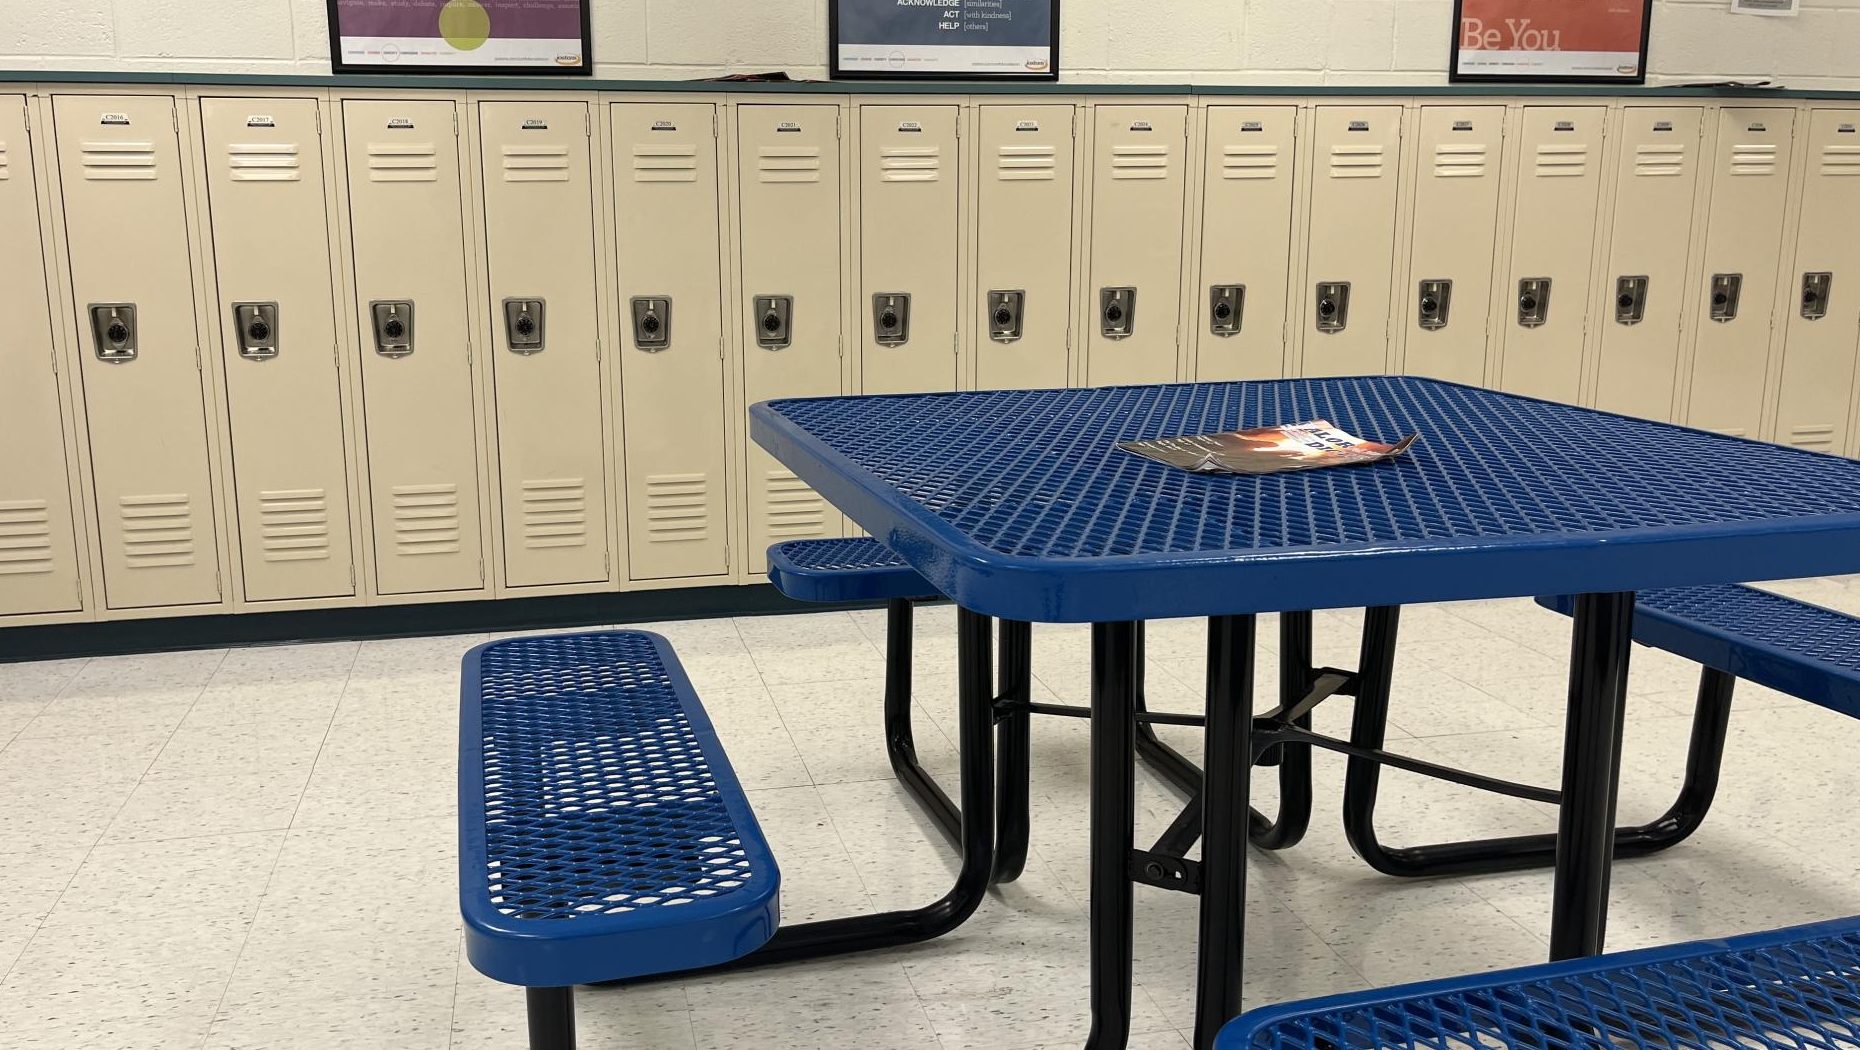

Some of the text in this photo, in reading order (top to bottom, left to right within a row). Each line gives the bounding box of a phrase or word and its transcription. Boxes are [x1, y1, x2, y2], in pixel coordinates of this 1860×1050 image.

[938, 22, 960, 30] HELP
[1460, 17, 1561, 51] Be You
